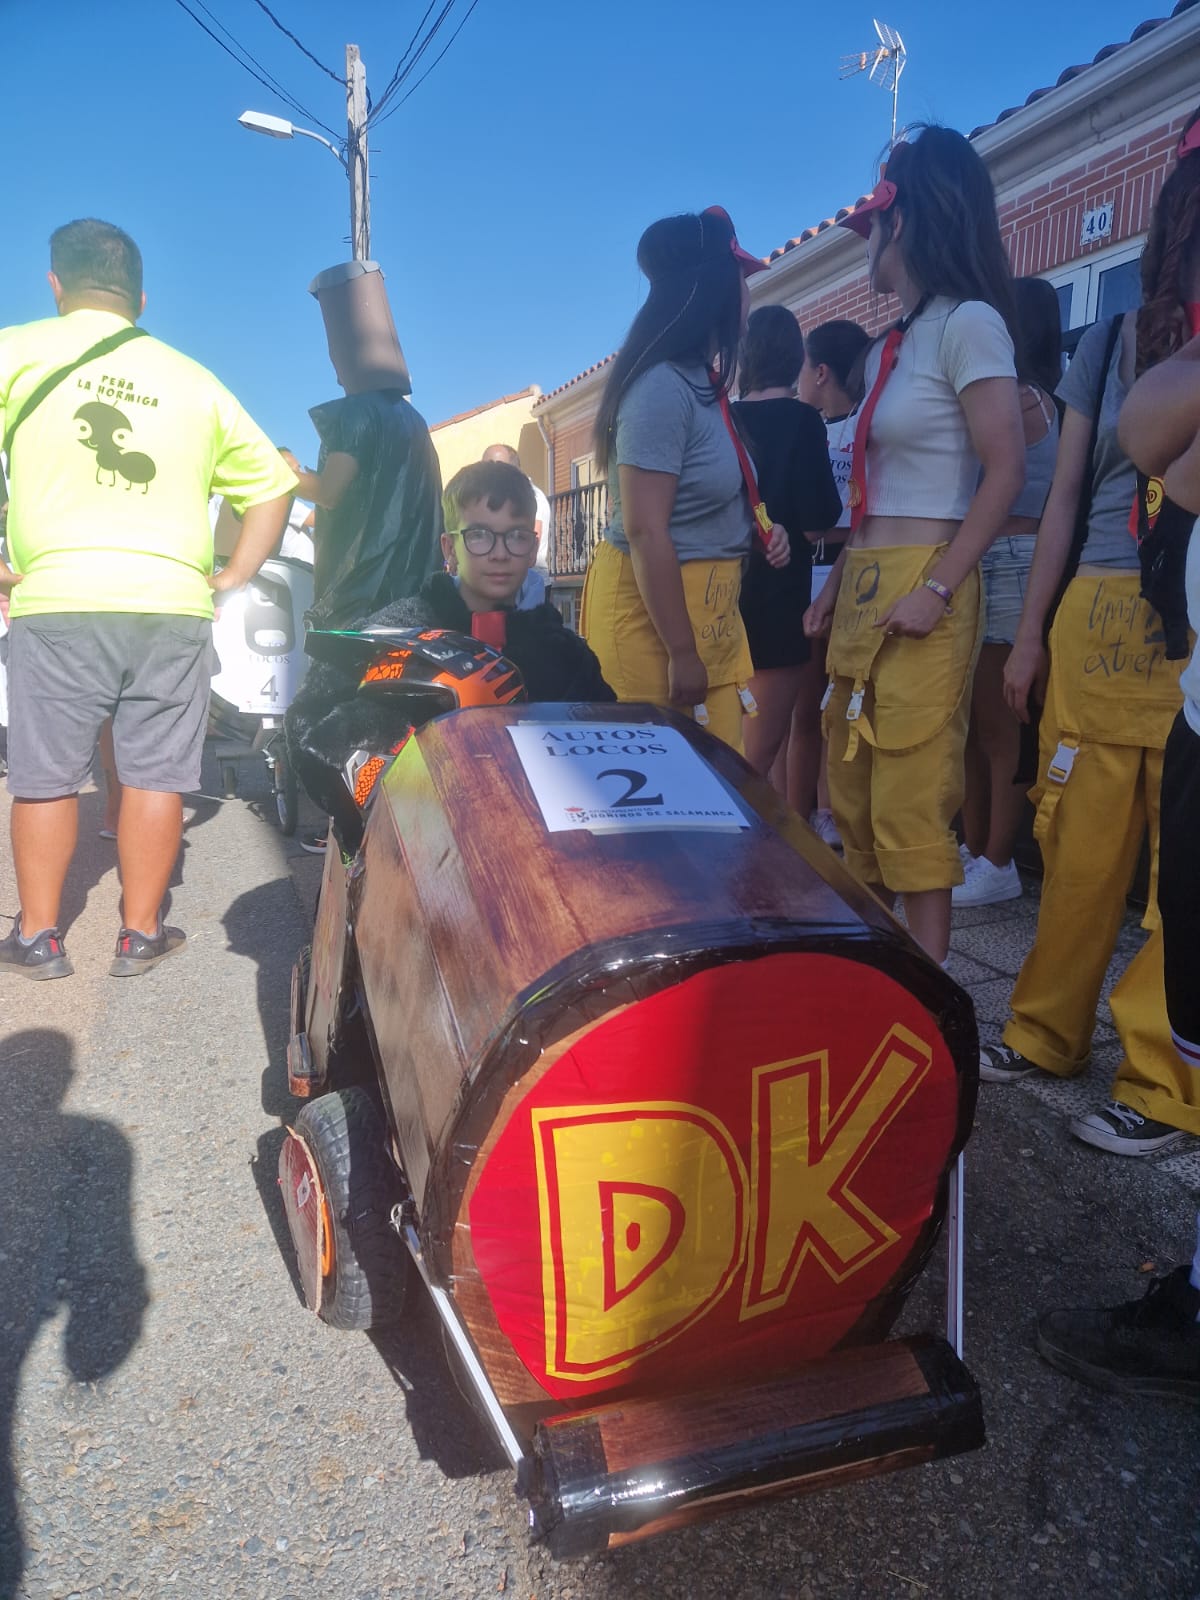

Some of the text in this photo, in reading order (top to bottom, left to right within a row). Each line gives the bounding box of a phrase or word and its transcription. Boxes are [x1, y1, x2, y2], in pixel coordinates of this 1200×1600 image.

[1086, 212, 1107, 234] 40
[77, 379, 159, 408] LA HORMIGA
[101, 375, 134, 391] PEÑA
[260, 675, 279, 702] 4
[542, 729, 656, 742] AUTOS
[546, 743, 668, 757] LOCOS
[596, 768, 664, 808] 2
[531, 1022, 932, 1382] DK
